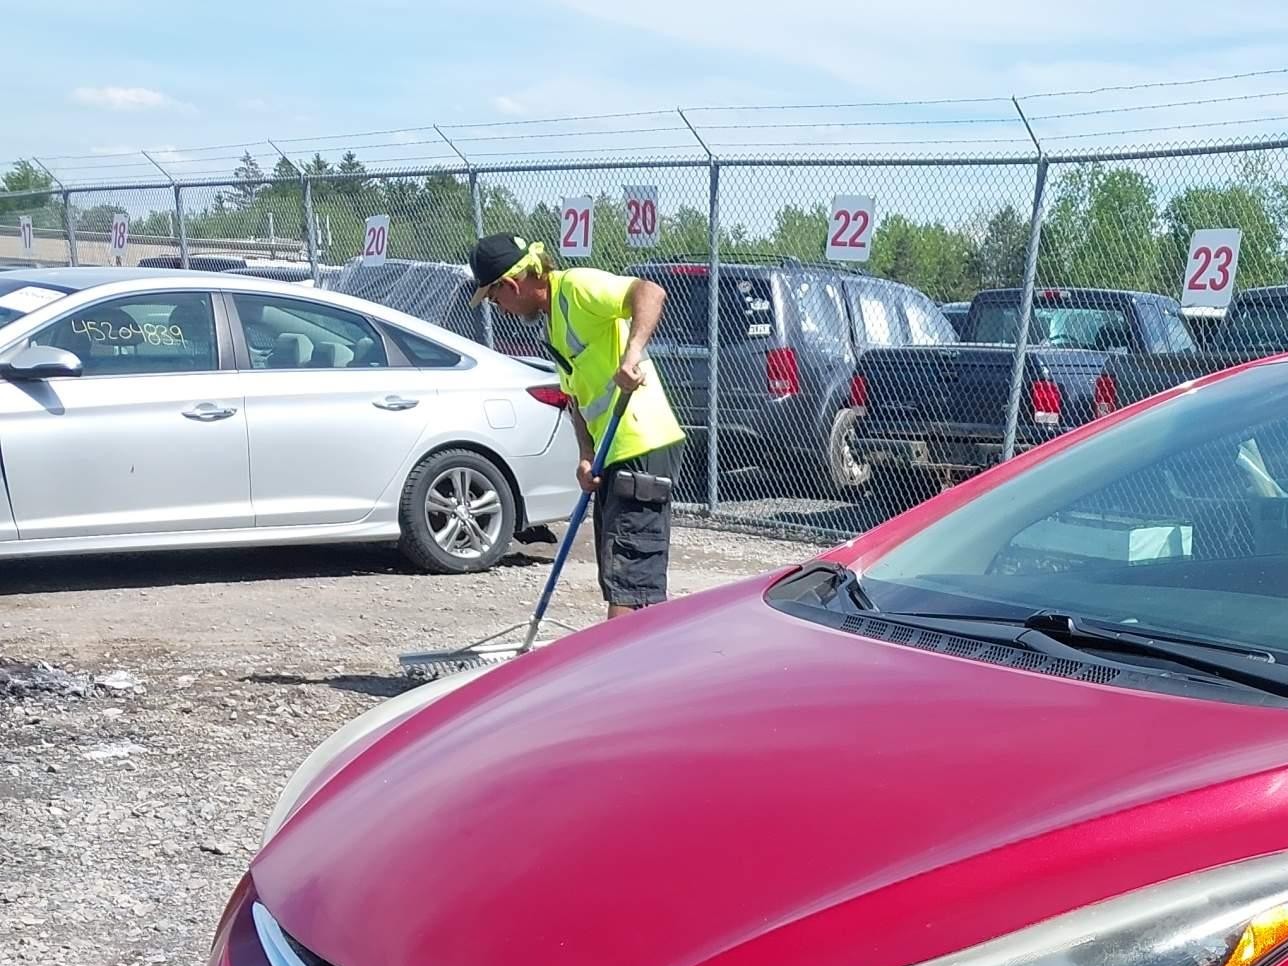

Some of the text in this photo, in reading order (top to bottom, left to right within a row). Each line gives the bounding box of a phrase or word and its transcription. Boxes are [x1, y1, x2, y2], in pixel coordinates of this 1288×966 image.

[563, 208, 590, 248] 21
[627, 199, 656, 236] 20
[831, 209, 870, 248] 22
[22, 223, 32, 249] 17
[113, 222, 126, 249] 18
[365, 226, 386, 256] 20
[1188, 245, 1233, 292] 23
[71, 320, 187, 349] 45204839
